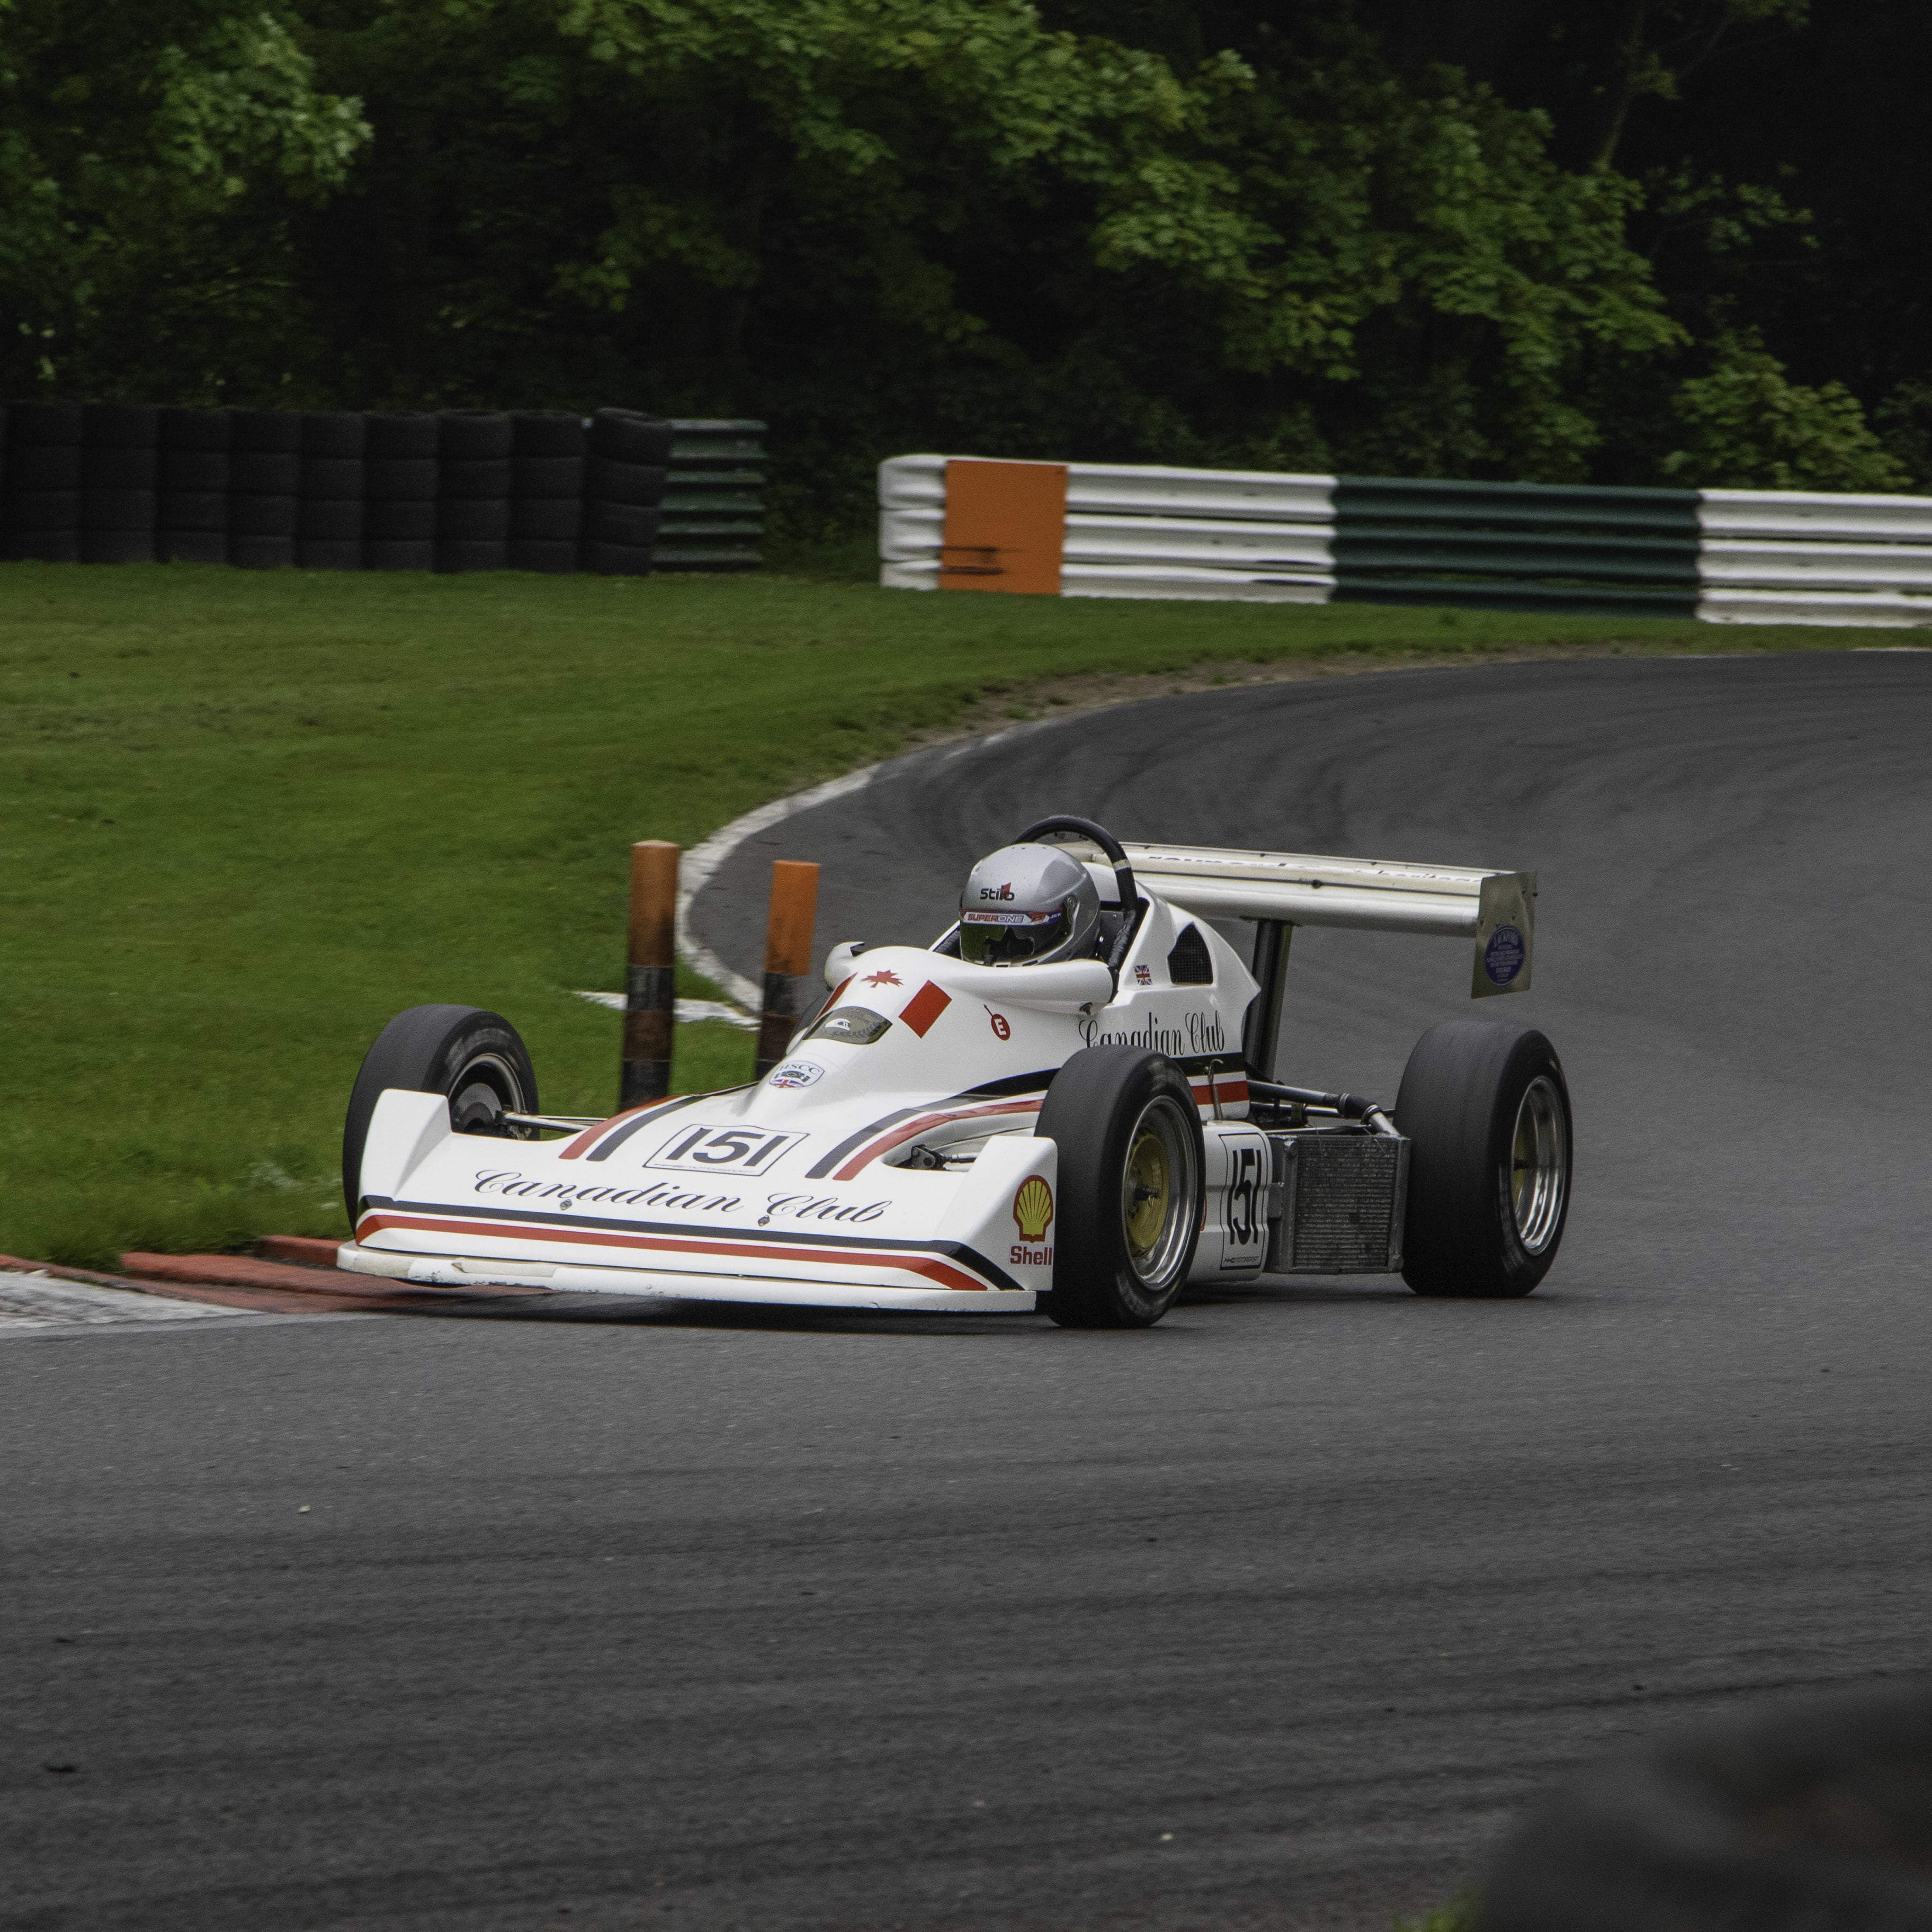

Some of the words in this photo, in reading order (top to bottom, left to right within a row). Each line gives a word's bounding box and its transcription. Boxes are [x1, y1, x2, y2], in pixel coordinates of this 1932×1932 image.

[980, 882, 1015, 901] Stilo
[994, 1018, 1007, 1036] E
[1078, 1012, 1185, 1056] Canadian
[1185, 1010, 1225, 1053] Club
[780, 1063, 820, 1075] HSCC
[665, 1127, 791, 1167] 151
[474, 1169, 744, 1212] Canadian
[767, 1193, 892, 1222] Club
[1227, 1148, 1262, 1245] 151
[1010, 1245, 1052, 1265] Shell
